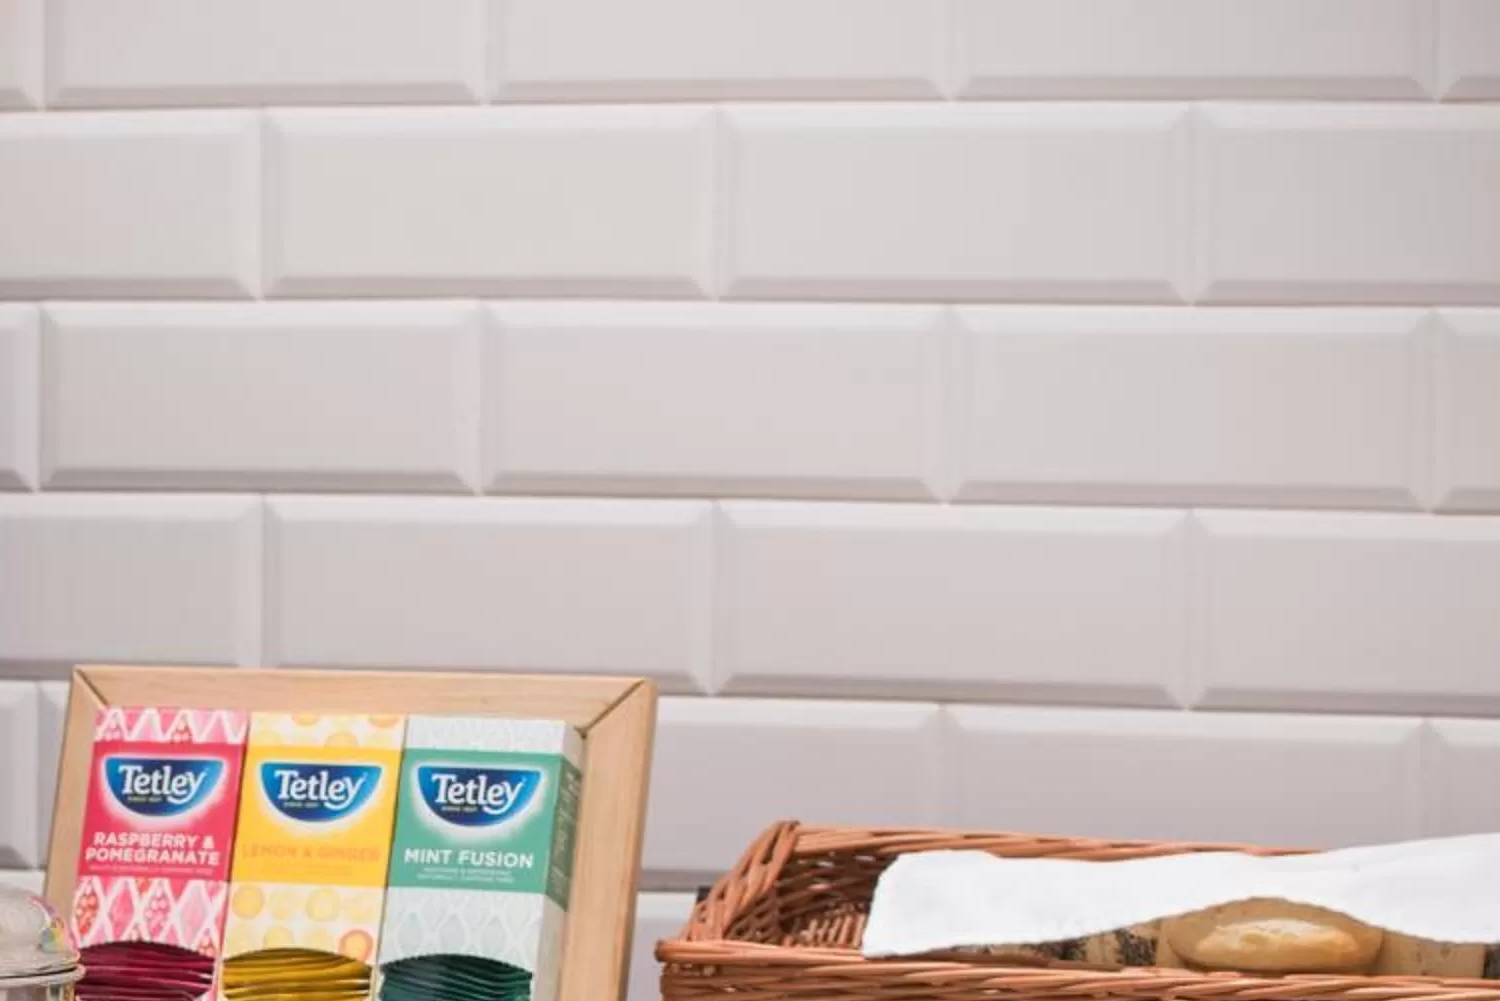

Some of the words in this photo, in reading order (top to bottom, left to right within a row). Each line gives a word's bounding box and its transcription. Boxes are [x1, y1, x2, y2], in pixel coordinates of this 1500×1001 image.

[118, 765, 208, 805] Tetley
[274, 769, 367, 811] Tetley
[431, 773, 525, 815] Tetley
[85, 847, 221, 866] POMEGRANATE
[93, 832, 200, 849] RASPBERRY
[202, 835, 216, 850] &
[403, 847, 453, 865] MINT
[457, 850, 534, 869] FUSION
